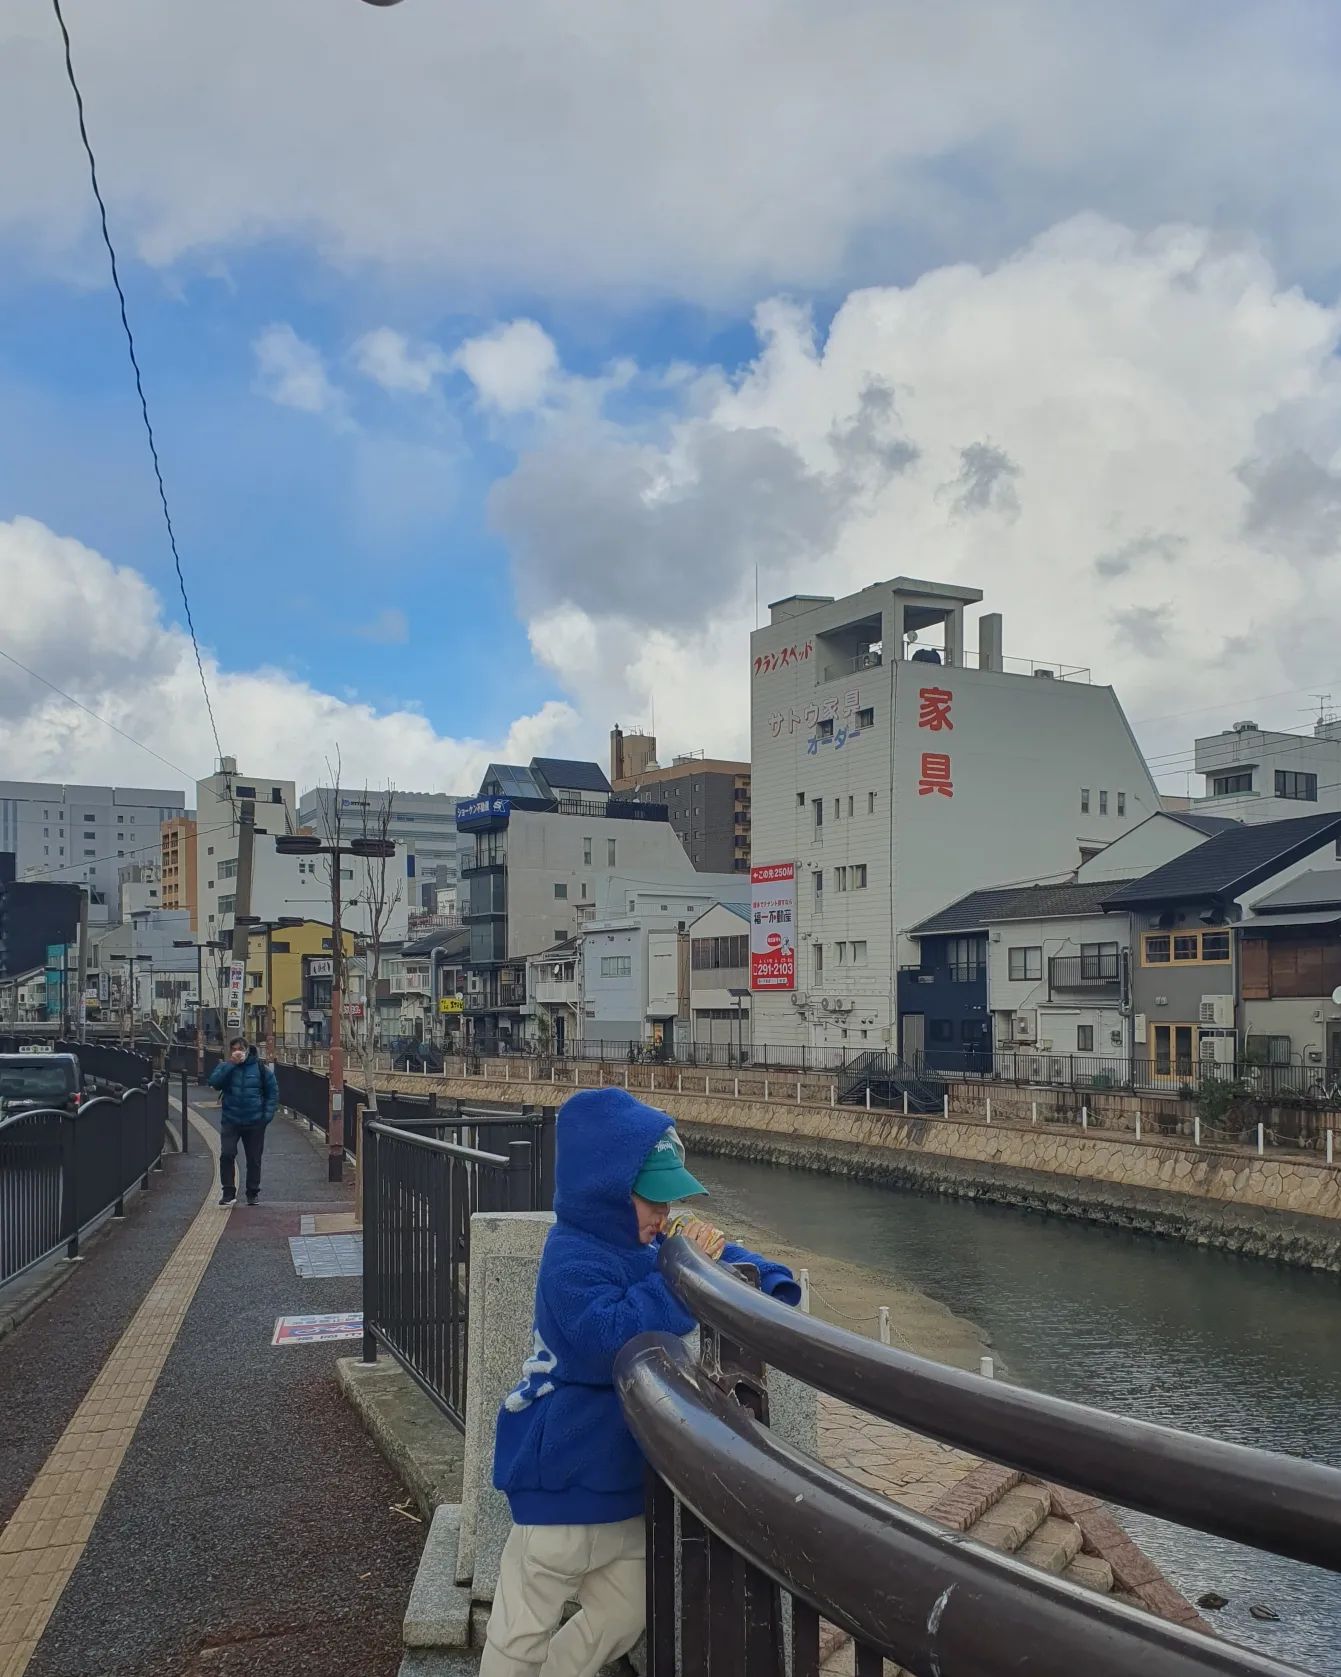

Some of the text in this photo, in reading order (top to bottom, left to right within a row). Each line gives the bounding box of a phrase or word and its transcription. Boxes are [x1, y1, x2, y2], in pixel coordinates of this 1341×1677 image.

[767, 688, 861, 738] サトウ家具
[807, 725, 860, 755] オーダー
[917, 686, 953, 797] 家具
[753, 909, 792, 925] 福一不動産
